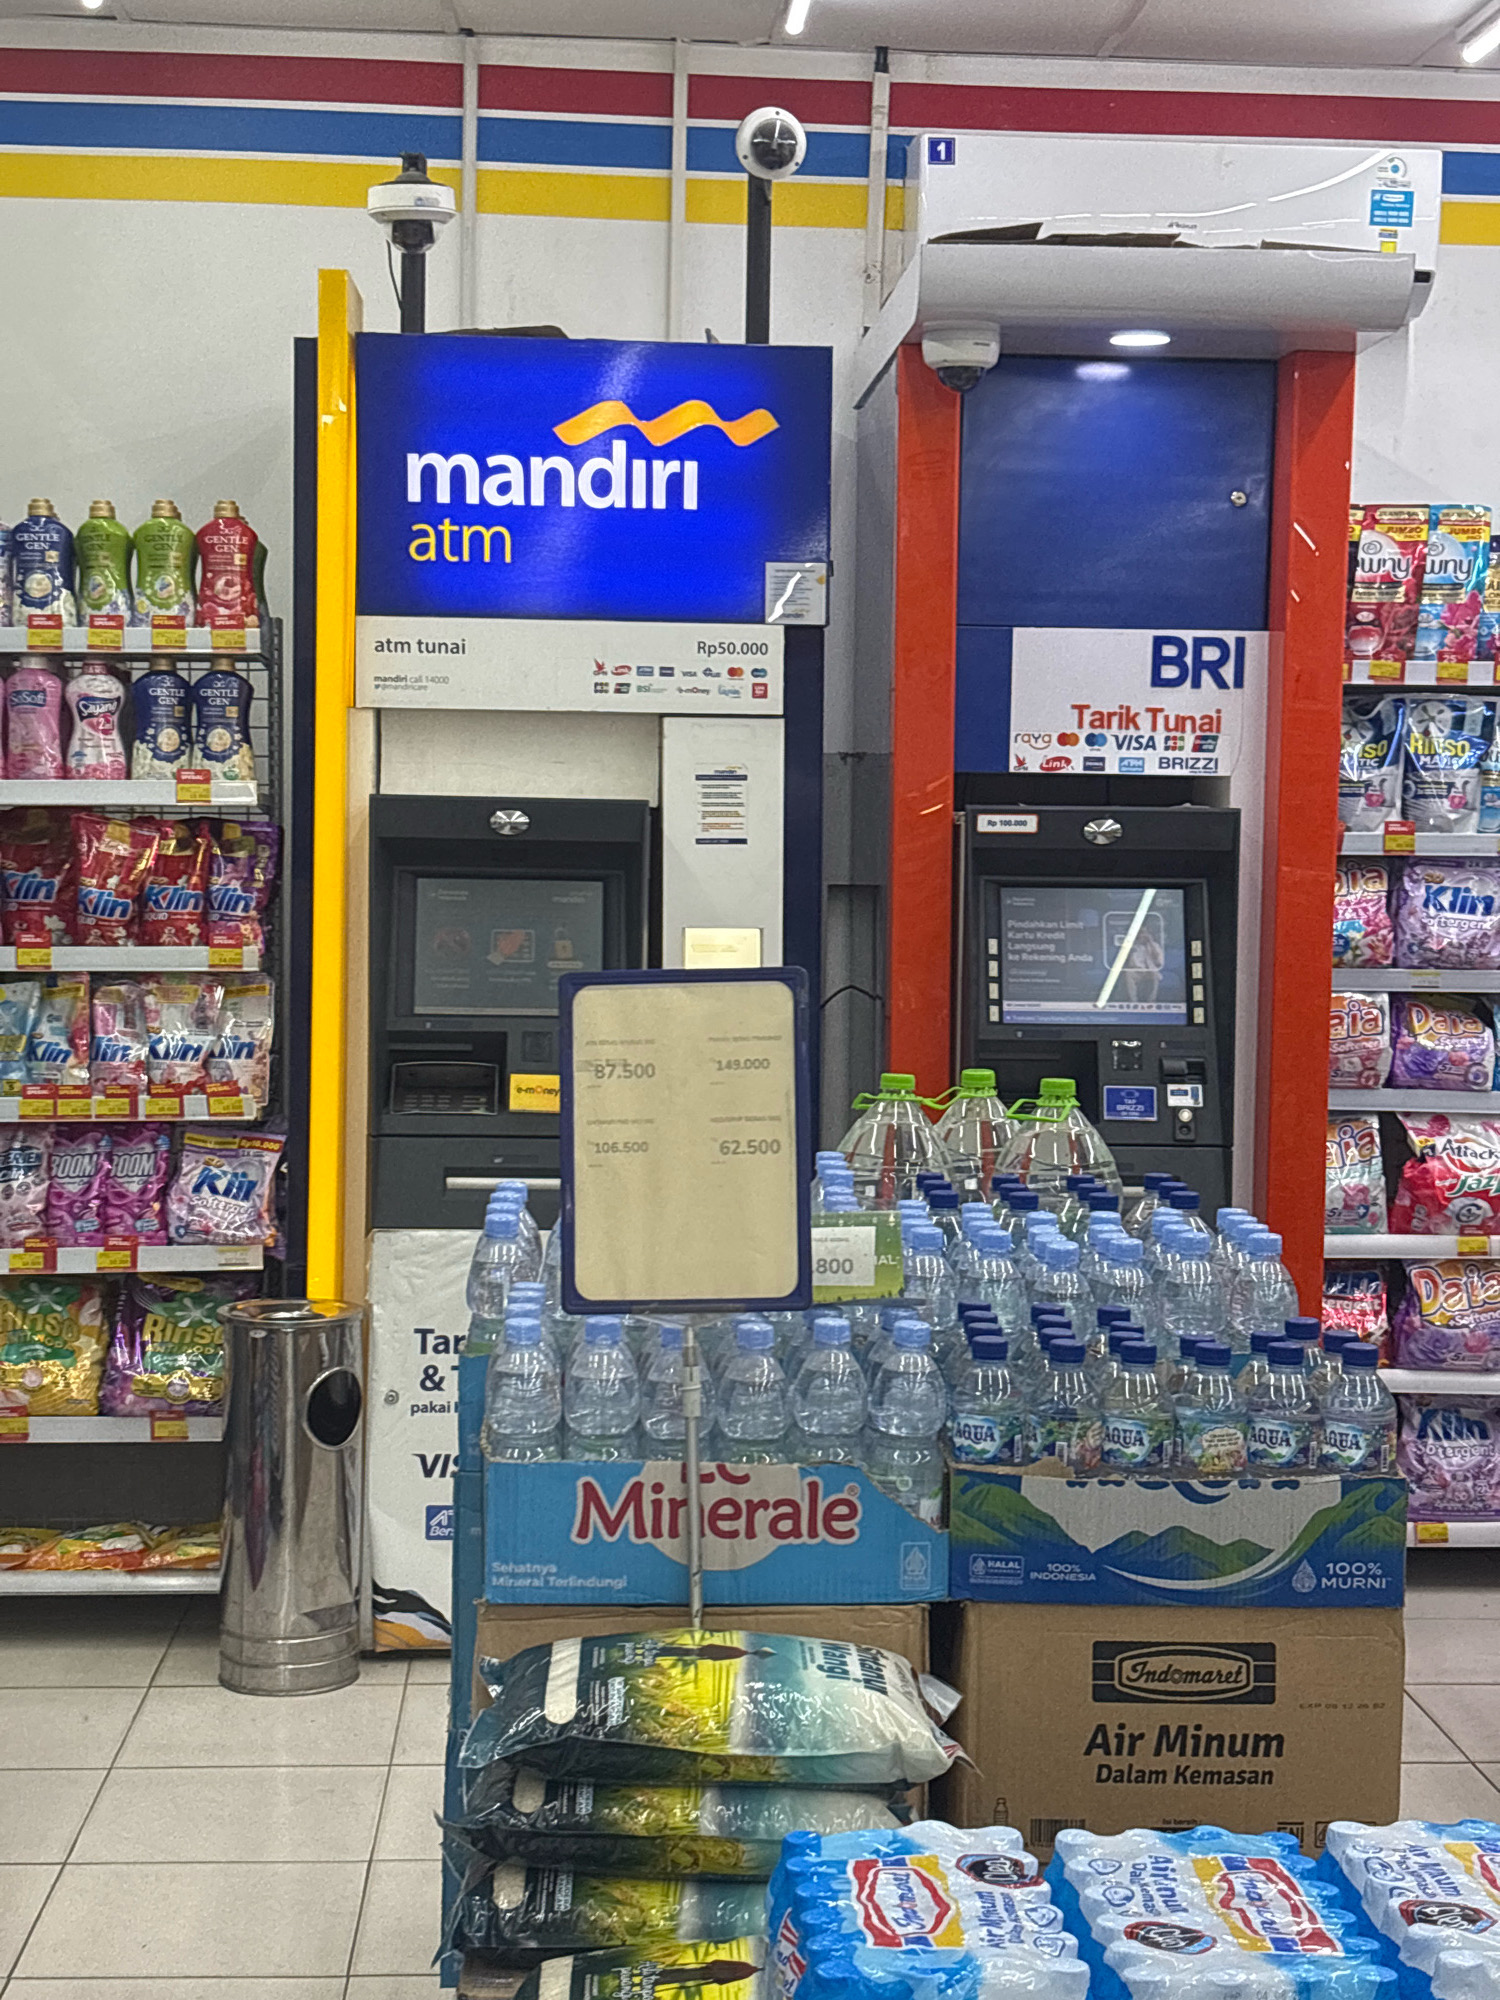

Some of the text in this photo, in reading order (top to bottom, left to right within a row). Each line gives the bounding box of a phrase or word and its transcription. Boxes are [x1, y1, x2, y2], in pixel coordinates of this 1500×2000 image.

[936, 142, 947, 161] 1
[407, 440, 698, 510] mandiri
[15, 532, 60, 542] GENTLE
[204, 535, 249, 545] GENTLE
[408, 517, 512, 563] atm
[25, 541, 50, 550] GEN
[214, 544, 239, 553] GEN
[1357, 556, 1412, 580] wny
[374, 638, 466, 655] atm tunai
[697, 640, 769, 660] Rp50.000
[1150, 635, 1246, 689] BRI
[374, 675, 407, 683] mandiri
[425, 676, 450, 684] 14000
[149, 688, 186, 698] GENTLE
[158, 696, 178, 705] GEN
[200, 688, 239, 698] GENTLE
[208, 696, 230, 705] GEN
[1071, 704, 1222, 733] Tarik Tunai
[1014, 733, 1052, 747] raya
[1111, 734, 1156, 750] VISA
[1158, 756, 1218, 770] BRIZZI
[987, 819, 1028, 828] Rp 100.000
[145, 884, 203, 912] Klin
[209, 884, 256, 914] Klin
[1422, 885, 1494, 916] Klin
[1007, 920, 1084, 929] Pindahkan Limit
[1037, 931, 1065, 939] Kredit
[1007, 942, 1055, 952] Langsung
[1022, 954, 1066, 964] Rekening
[1068, 954, 1093, 962] Anda
[1407, 1002, 1486, 1037] Daia
[149, 1036, 204, 1060] Klin
[594, 1062, 656, 1079] 87.500
[716, 1058, 770, 1071] 149.000
[594, 1141, 649, 1154] 106.500
[719, 1139, 781, 1155] 62.500
[414, 1328, 465, 1355] Tar
[419, 1365, 445, 1391] &
[411, 1400, 451, 1416] pakai
[1417, 1407, 1490, 1442] Klin
[955, 1422, 997, 1444] AQUA
[1104, 1425, 1146, 1448] AQUA
[1251, 1426, 1292, 1449] AQUA
[576, 1478, 859, 1541] Minerale
[492, 1562, 557, 1575] Sehatnya
[987, 1560, 1021, 1569] HALAL
[1047, 1563, 1081, 1572] 100%
[1326, 1562, 1382, 1576] 100%
[492, 1575, 628, 1590] Mineral Terlindungi
[1030, 1572, 1096, 1581] INDONESIA
[1321, 1576, 1388, 1590] MURNI
[815, 1641, 863, 1682] Wangi
[1126, 1660, 1244, 1686] Indomaret
[1084, 1724, 1284, 1757] Air Minum
[1096, 1763, 1274, 1785] Dalam Kemasan
